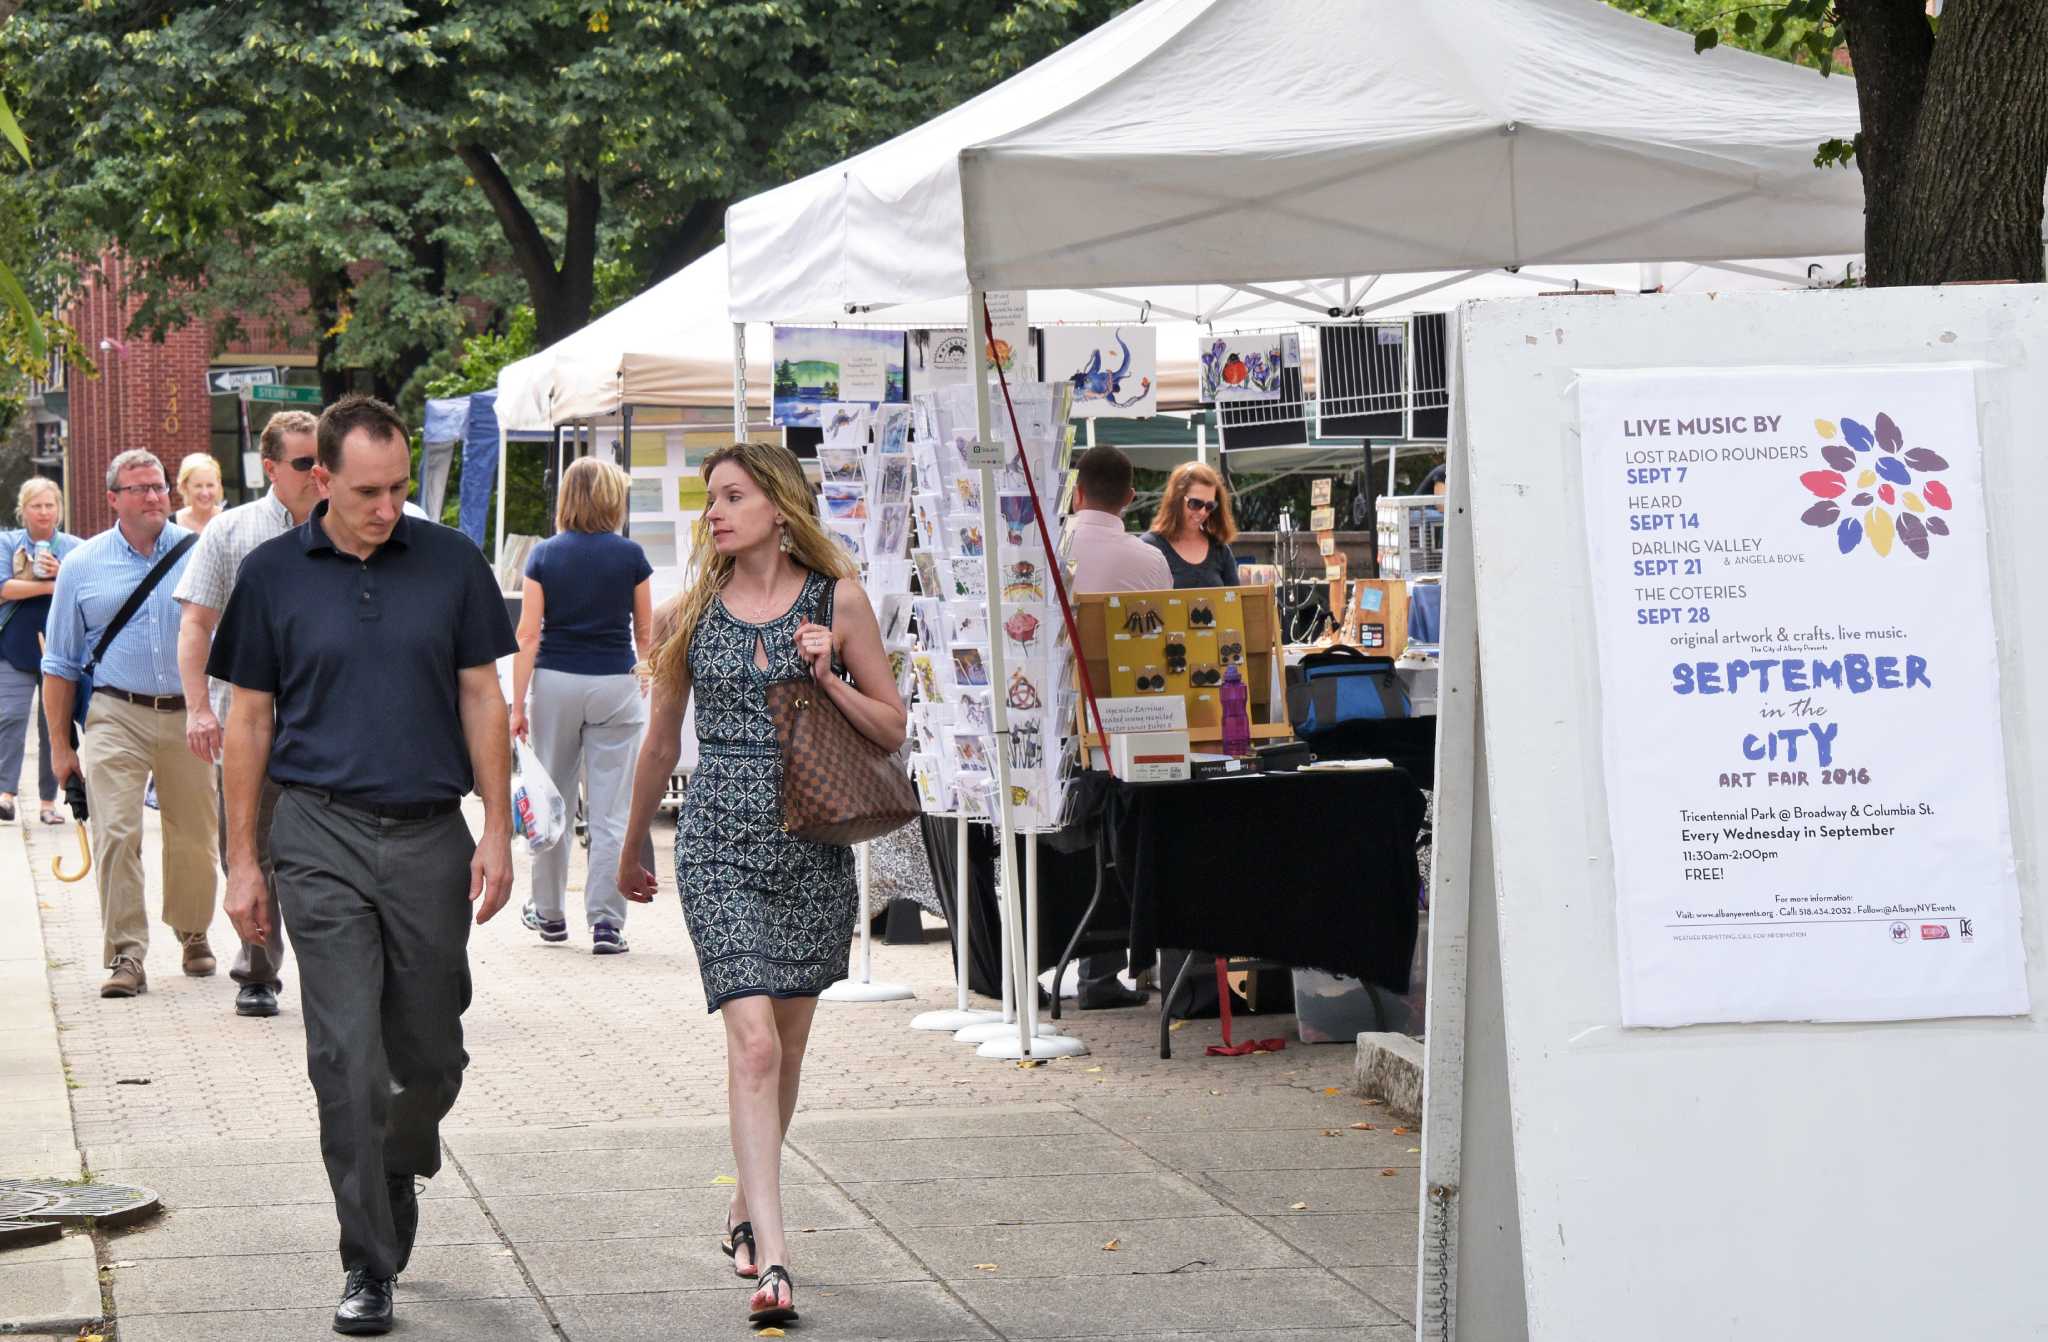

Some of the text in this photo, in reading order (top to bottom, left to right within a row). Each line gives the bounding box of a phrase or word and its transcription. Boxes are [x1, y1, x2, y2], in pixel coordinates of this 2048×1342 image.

[1624, 416, 1781, 437] LIVE MUSIC BY
[1626, 445, 1808, 464] LOST RADIO ROUNDERS
[1627, 466, 1687, 485] SEPT 7
[1629, 495, 1682, 510] HEARD
[1630, 513, 1699, 531] SEPT 14
[1632, 538, 1762, 555] DARLING VALLEY
[1634, 559, 1702, 576] SEPT 21
[1723, 553, 1805, 566] & ANGELA BOVE
[1634, 585, 1747, 601] THE COTERIES
[1637, 607, 1710, 624] SEPT 28
[1670, 629, 1718, 649] original
[1722, 627, 1773, 644] artwork
[1777, 627, 1790, 642] &
[1838, 625, 1862, 640] live
[1865, 626, 1907, 639] music.
[1673, 653, 1931, 695] SEPTEMBER
[1760, 697, 1827, 718] in the
[1743, 722, 1838, 767] CITY
[1719, 768, 1871, 788] ART FAIR 2016
[1680, 803, 1934, 822] Tricentennial Park @ Broadway & Columbia St.
[1682, 824, 1895, 844] Every Wednesday in September
[1683, 849, 1778, 862] 11:30am-2:00pm
[1685, 868, 1723, 880] FREE!
[1775, 895, 1788, 903] For
